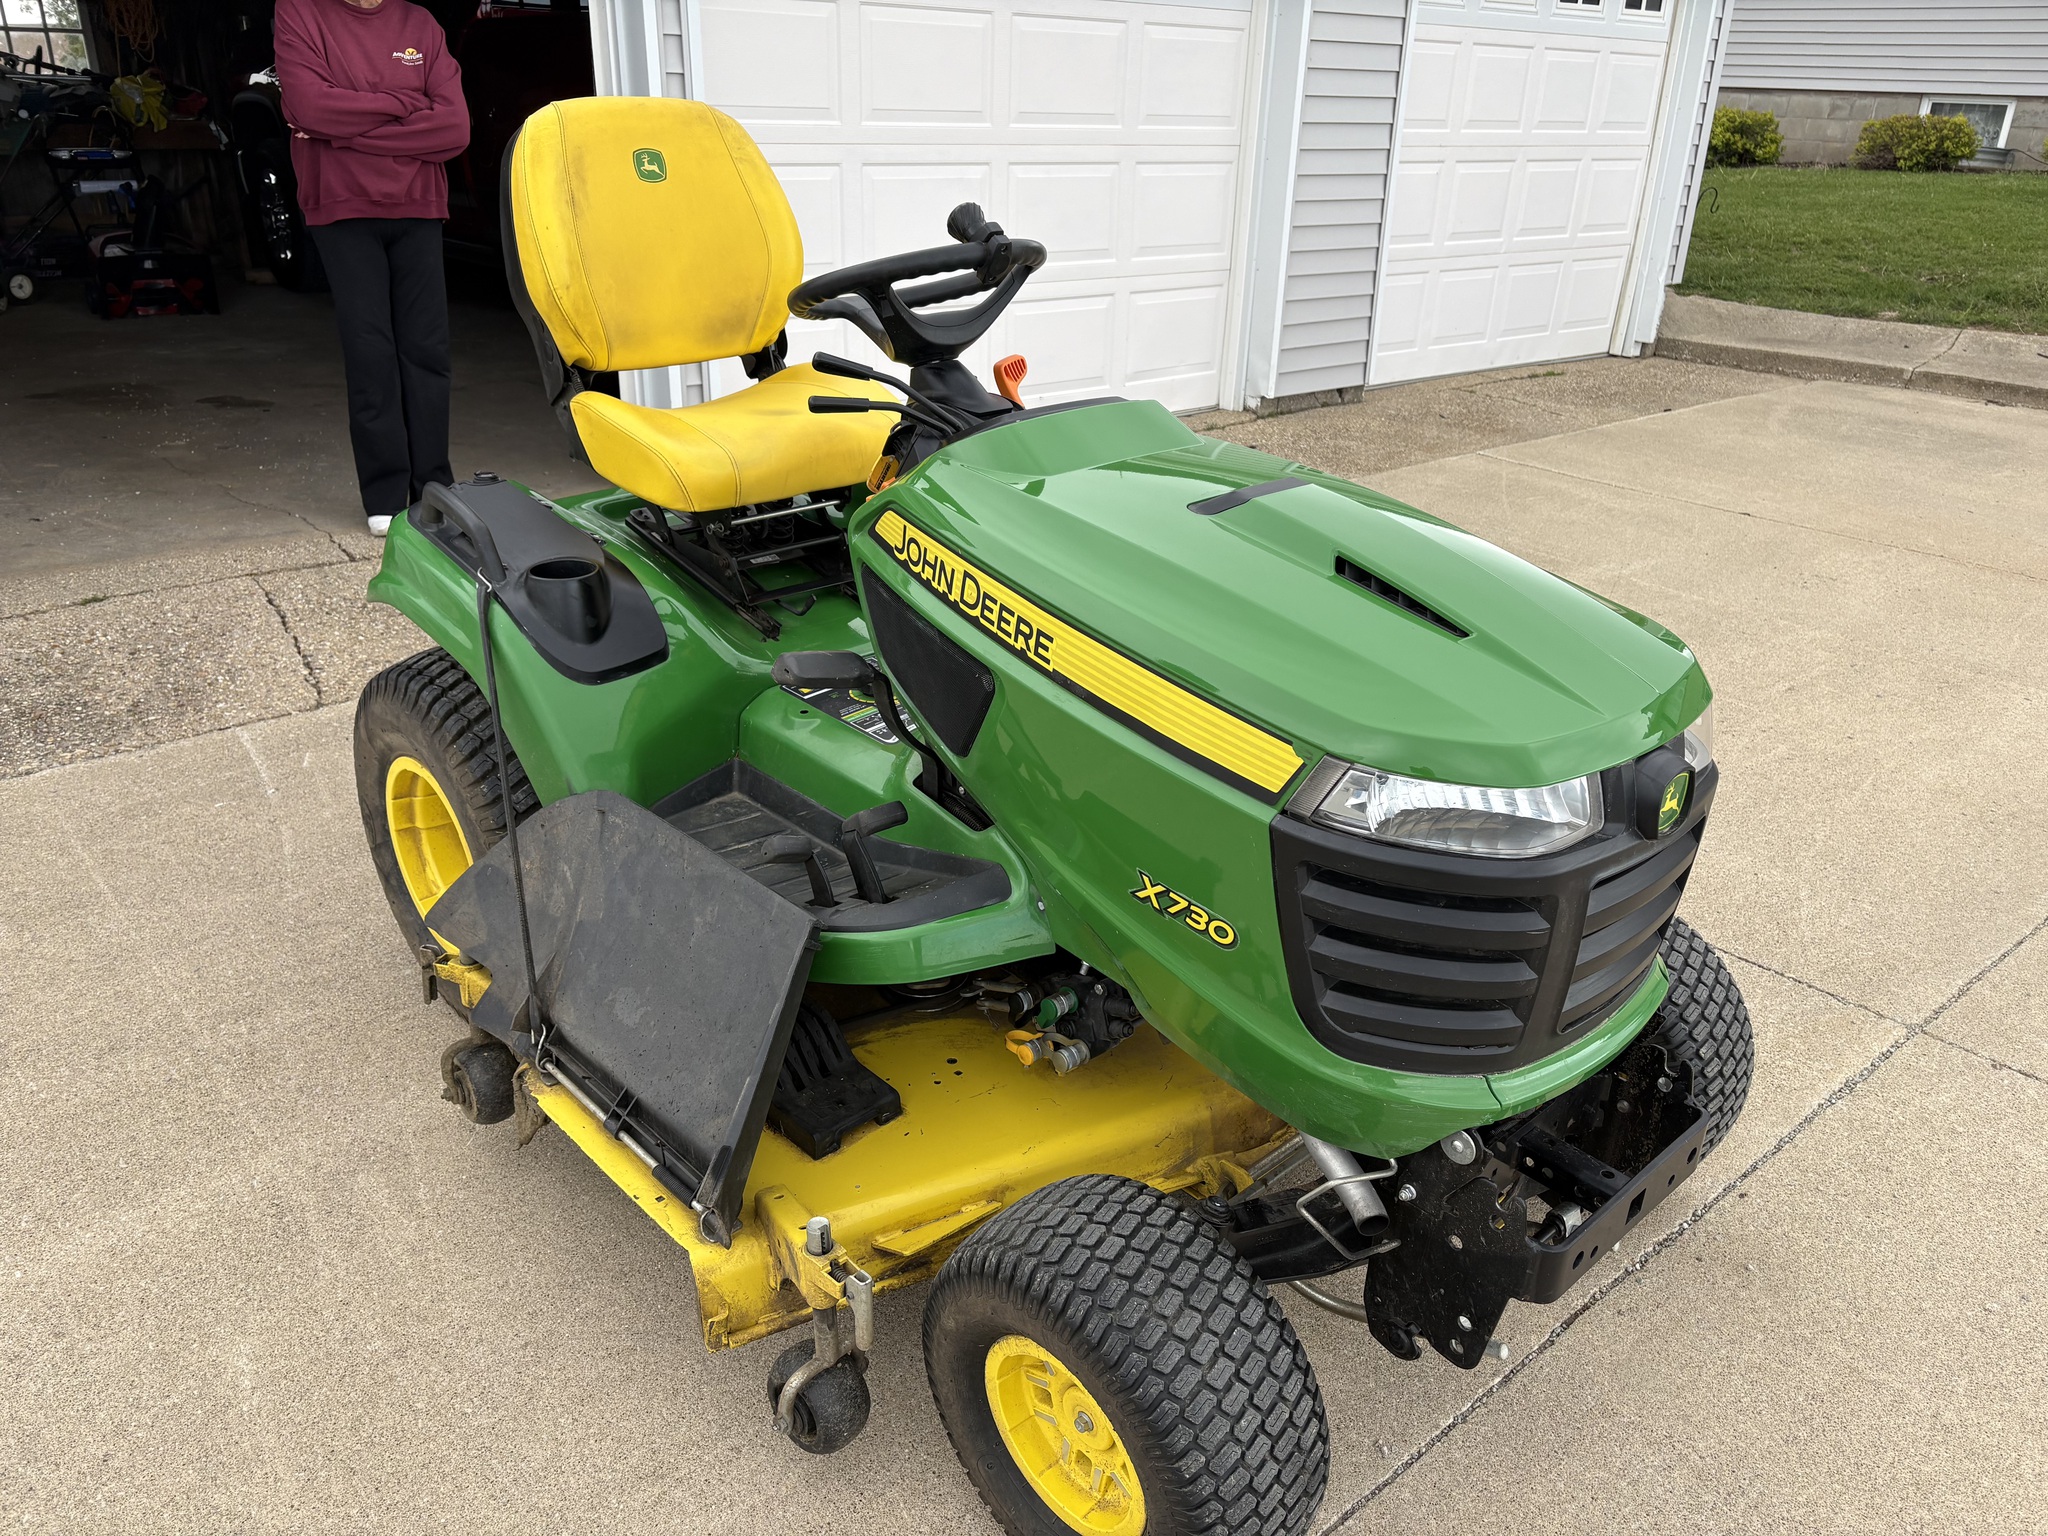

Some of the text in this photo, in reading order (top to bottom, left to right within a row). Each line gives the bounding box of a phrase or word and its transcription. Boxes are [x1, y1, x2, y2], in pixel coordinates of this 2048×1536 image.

[894, 525, 1055, 668] JOHN DEERE
[1131, 870, 1237, 948] X730
